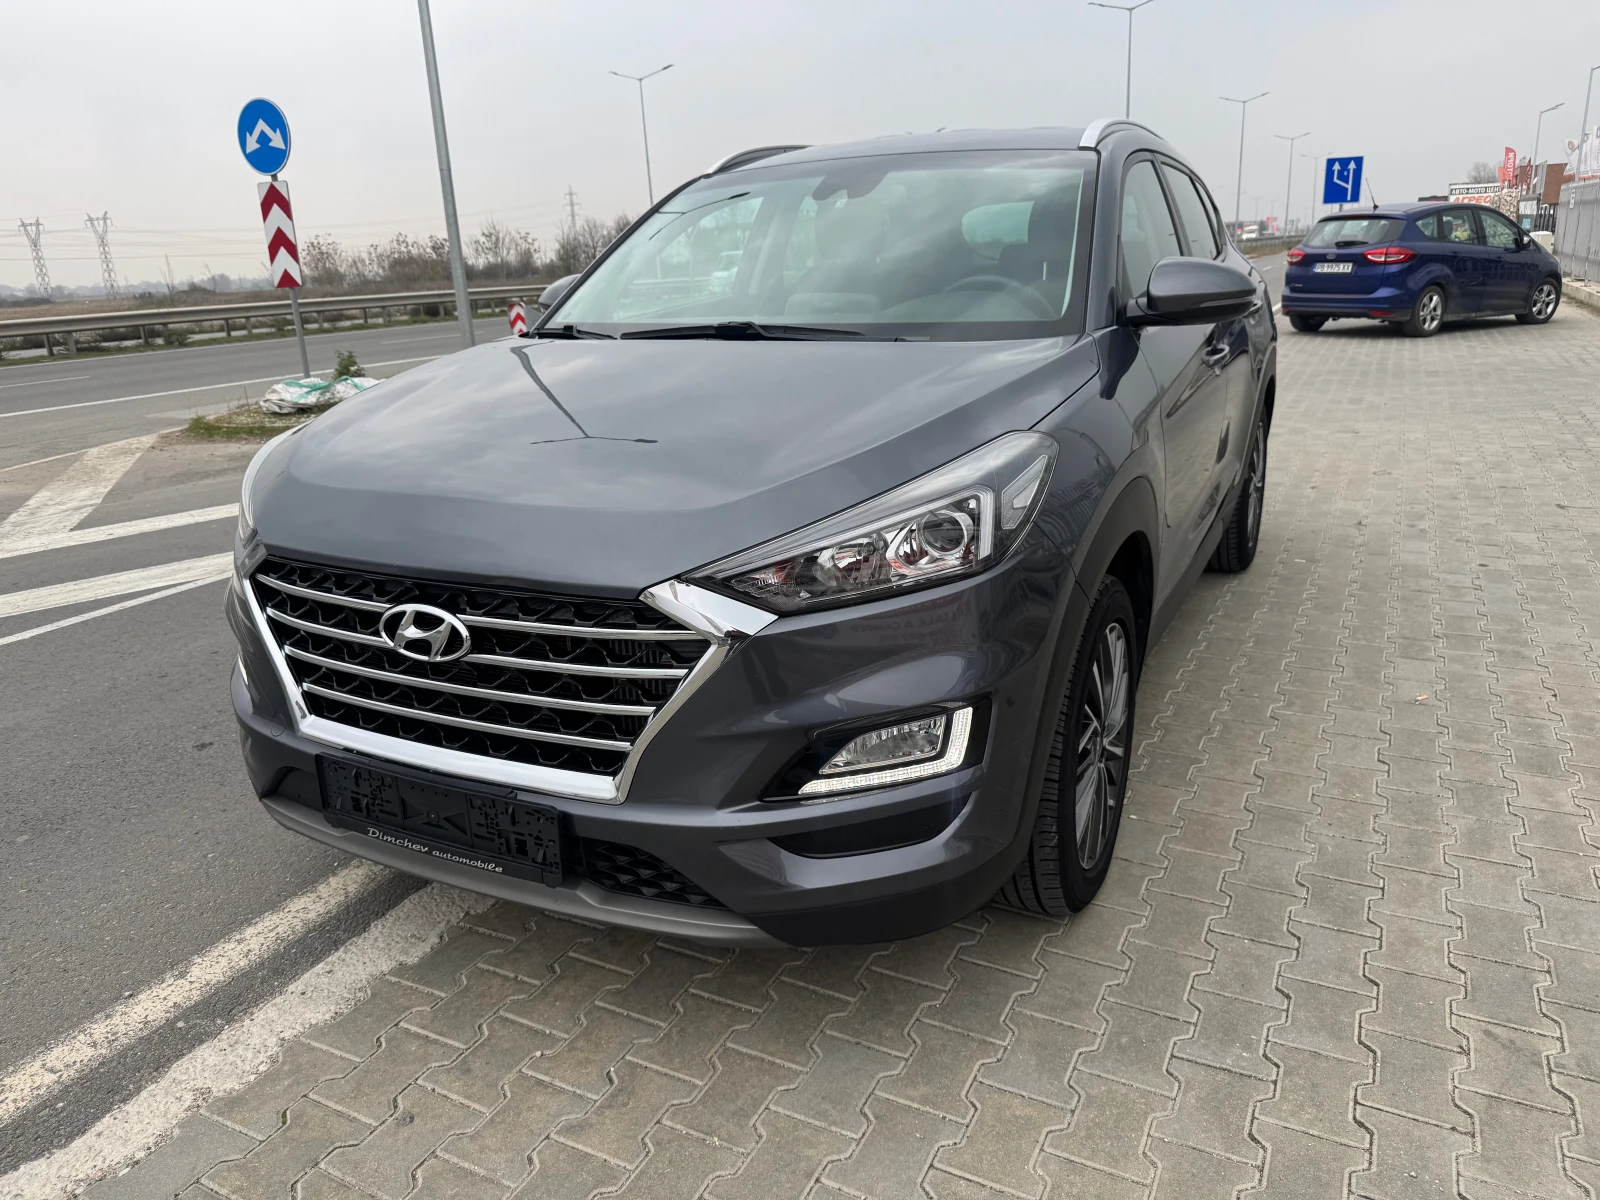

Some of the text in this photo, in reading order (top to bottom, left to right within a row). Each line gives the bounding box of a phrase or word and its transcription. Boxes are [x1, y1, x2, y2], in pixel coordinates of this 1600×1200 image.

[1451, 187, 1486, 195] АВТО-МОТО
[367, 827, 503, 873] Dimchev automobile
